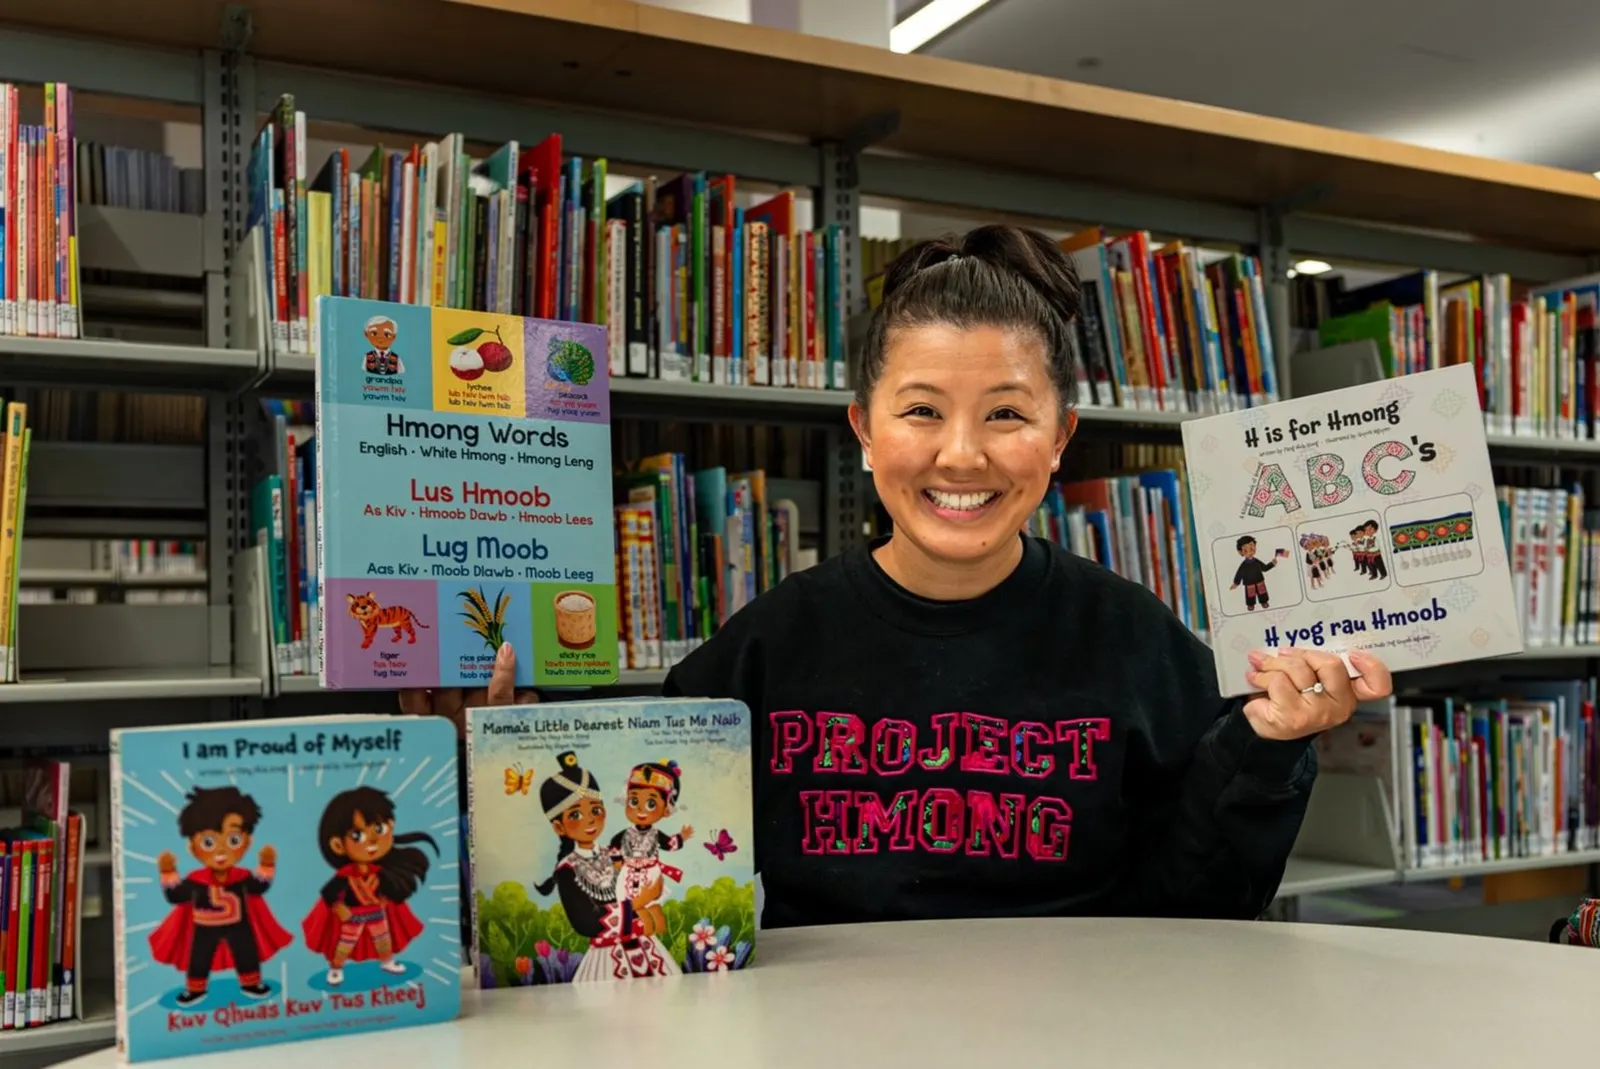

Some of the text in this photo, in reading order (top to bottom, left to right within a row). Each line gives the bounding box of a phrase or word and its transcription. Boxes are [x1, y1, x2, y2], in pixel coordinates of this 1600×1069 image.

[365, 376, 403, 386] grandpa
[467, 382, 492, 391] lychee
[363, 393, 389, 401] yawm
[387, 413, 569, 448] Hmong Words
[1245, 400, 1400, 448] H is for Hmong
[360, 442, 594, 470] English White Hmong Hmong Leng
[410, 479, 552, 507] Lus Hmoob
[363, 504, 594, 526] As Kiv Hmoob Dawb Hmoob Lees
[422, 534, 549, 563] Lug Moob
[367, 563, 594, 582] Aas Kiv Moob Dlawb Moob Leeg
[1265, 598, 1448, 648] H yog rau Hmoob
[380, 652, 399, 660] tiger
[460, 653, 475, 661] rice
[559, 652, 580, 660] sticky
[373, 669, 387, 678] tug
[482, 714, 742, 735] Mama's Little Dearest Niam Tus Me Naib
[182, 728, 403, 759] I am Proud of Myself
[769, 710, 1111, 780] PROJECT
[799, 788, 1074, 861] HMONG
[167, 1011, 205, 1032] Kuv
[213, 1002, 280, 1027] Qhuas
[285, 997, 322, 1017] Kuv
[330, 993, 365, 1010] Tus
[371, 984, 427, 1009] Kheej
